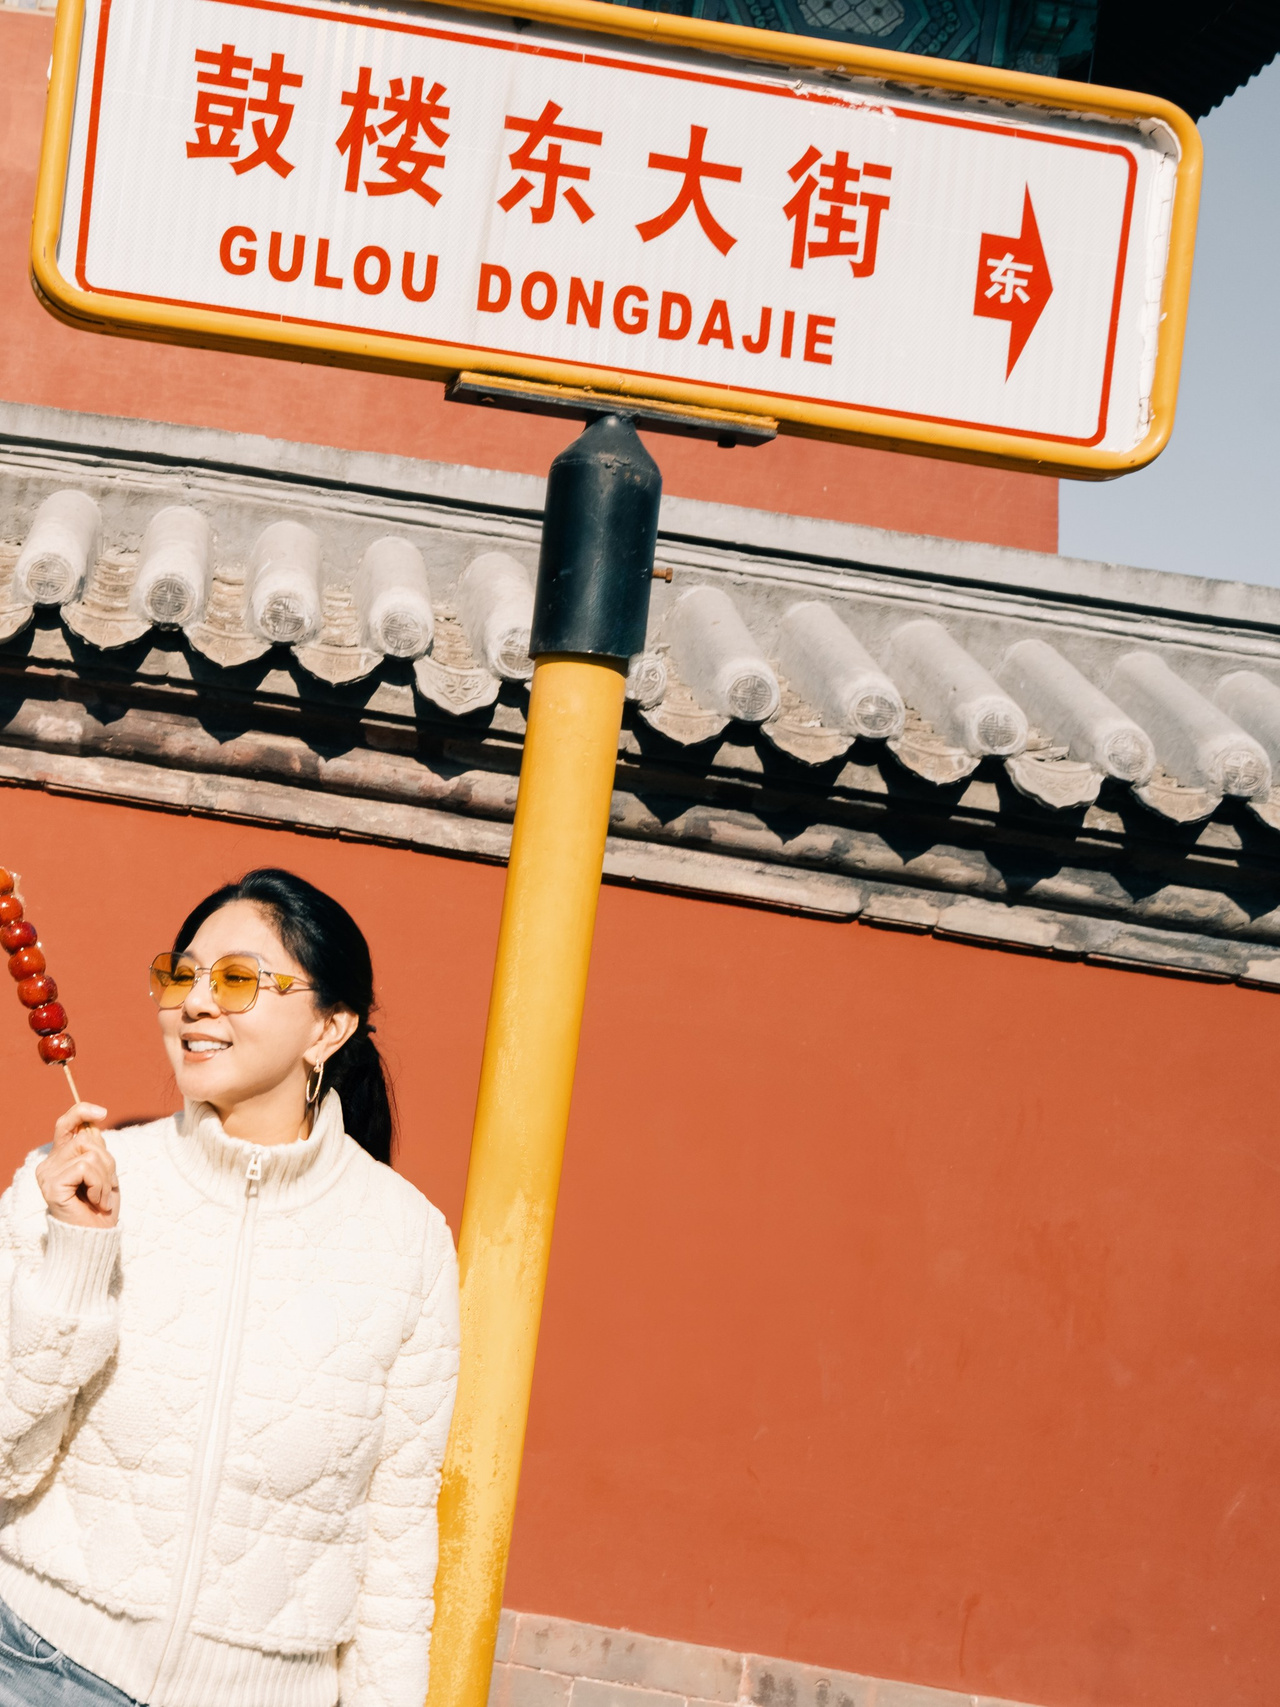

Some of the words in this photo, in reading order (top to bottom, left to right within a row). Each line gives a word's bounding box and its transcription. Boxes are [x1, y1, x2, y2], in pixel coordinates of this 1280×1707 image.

[185, 43, 893, 279] 鼓楼东大街
[219, 225, 439, 303] GULOU
[476, 262, 836, 365] DONGDAJIE
[984, 252, 1033, 304] 东
